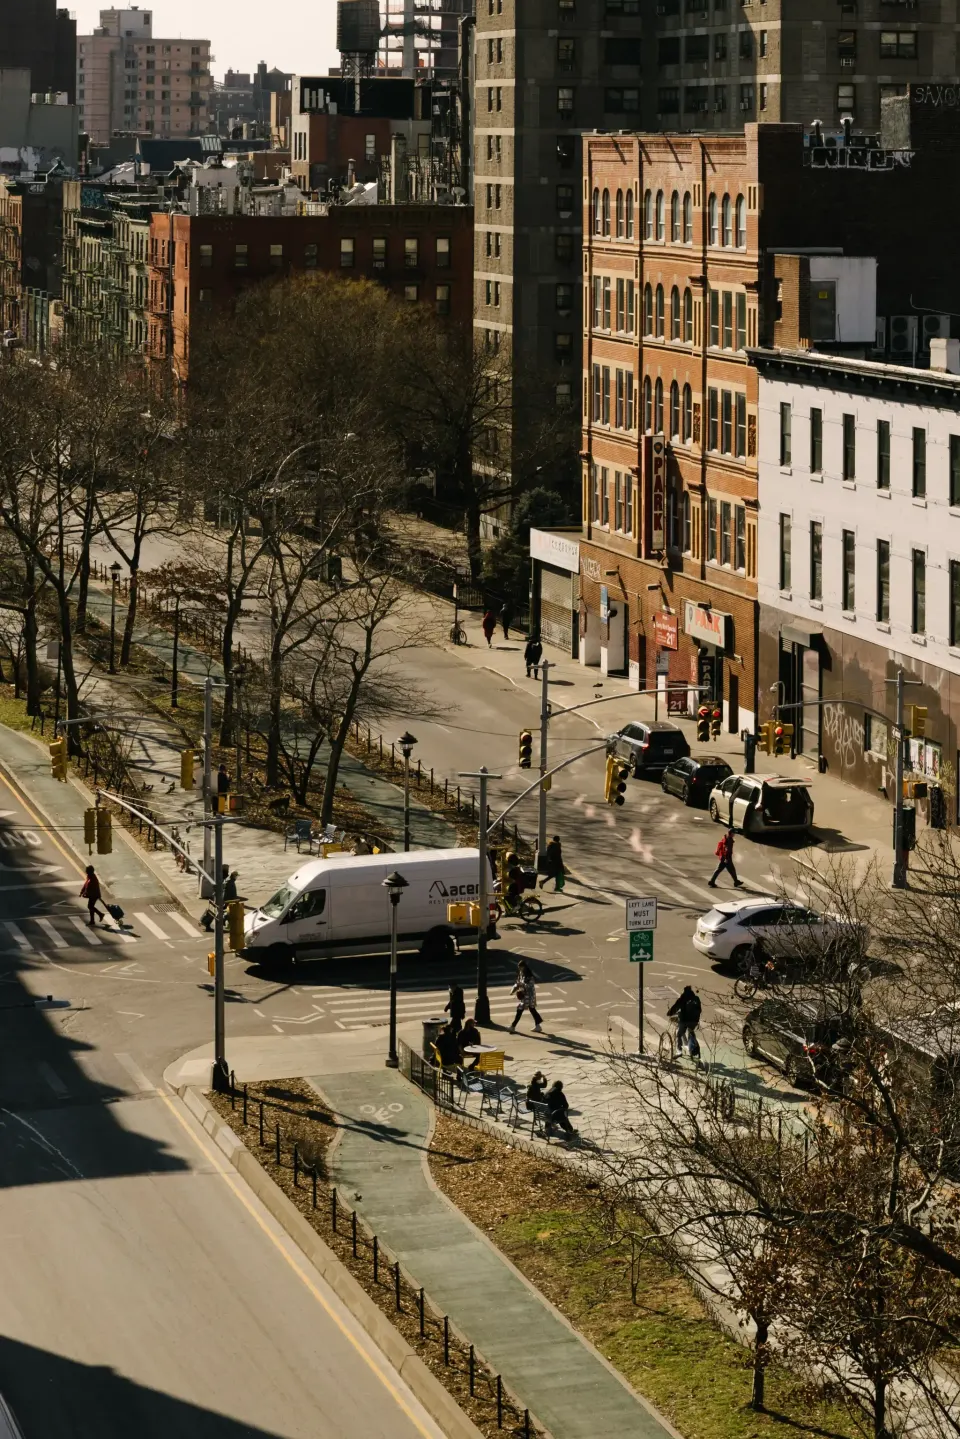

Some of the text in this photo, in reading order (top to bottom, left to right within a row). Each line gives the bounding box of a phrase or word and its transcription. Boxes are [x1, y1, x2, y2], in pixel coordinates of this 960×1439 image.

[653, 456, 663, 531] PARK
[695, 607, 721, 635] PARK
[628, 900, 655, 909] LEFT LANE
[633, 910, 650, 918] MUST
